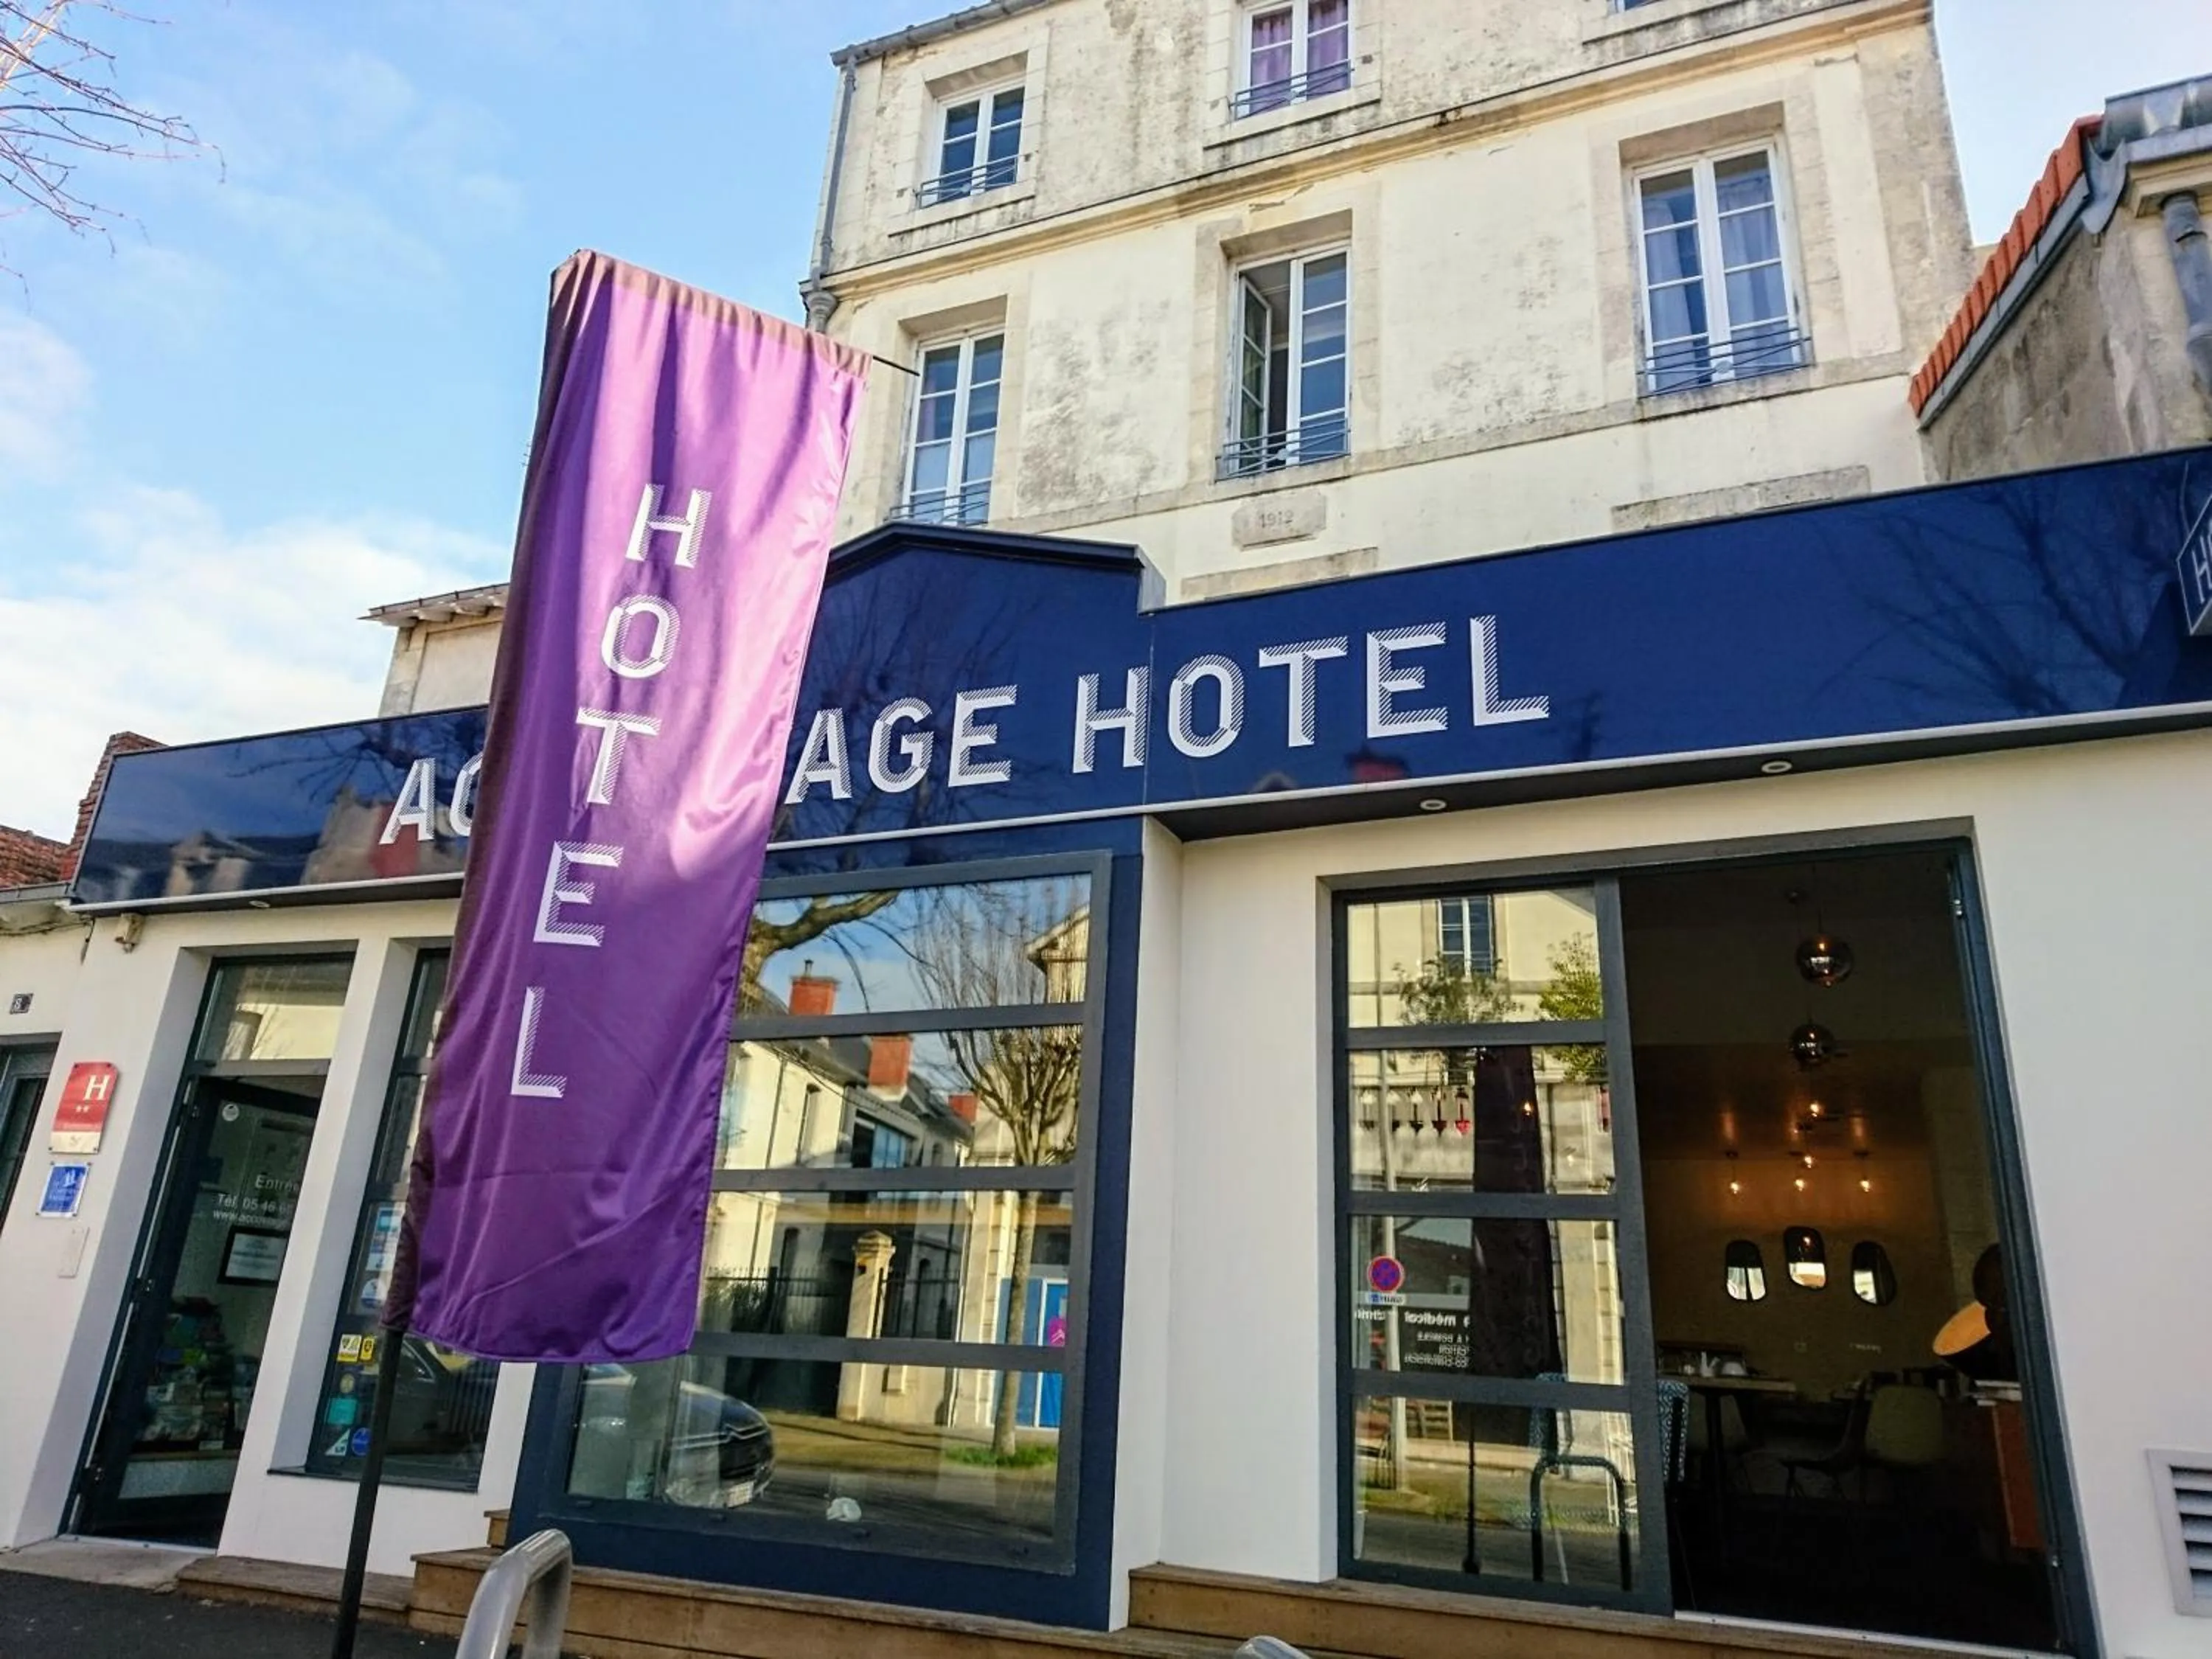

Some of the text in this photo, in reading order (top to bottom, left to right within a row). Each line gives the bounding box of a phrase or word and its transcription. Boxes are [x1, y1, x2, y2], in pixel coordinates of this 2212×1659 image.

[1073, 614, 1549, 773] HOTEL
[510, 484, 712, 1098] HOTEL
[83, 1074, 111, 1101] H
